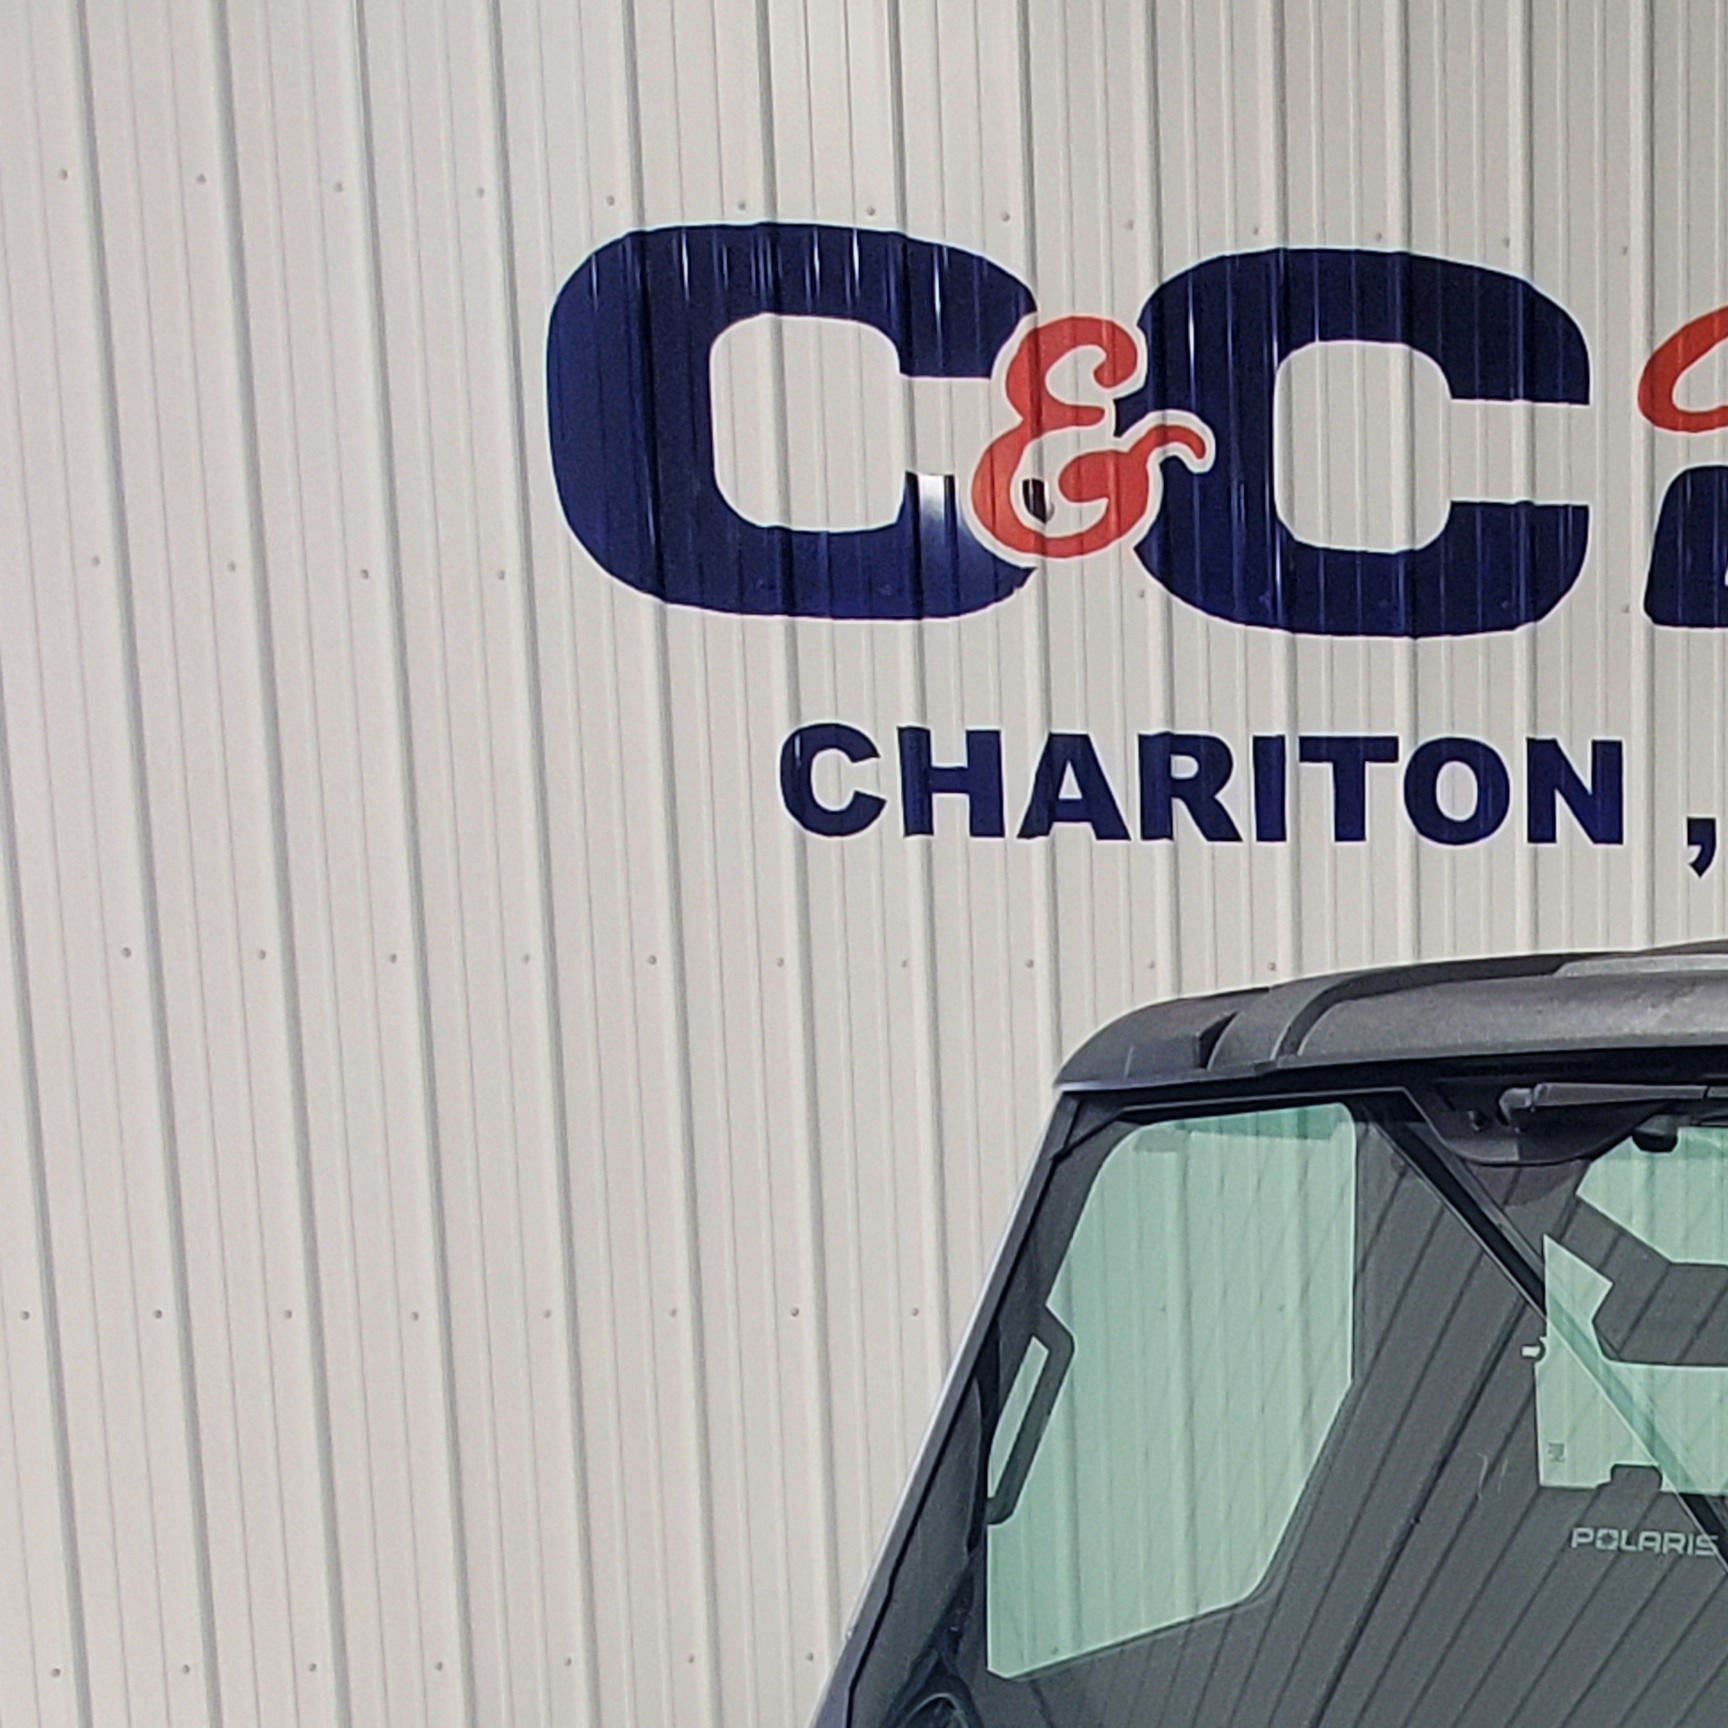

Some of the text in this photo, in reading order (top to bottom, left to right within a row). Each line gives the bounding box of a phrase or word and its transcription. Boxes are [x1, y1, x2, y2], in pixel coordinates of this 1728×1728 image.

[545, 220, 1592, 641] C&C
[780, 723, 1624, 846] CHARITON
[1571, 1526, 1718, 1556] POLARIS
